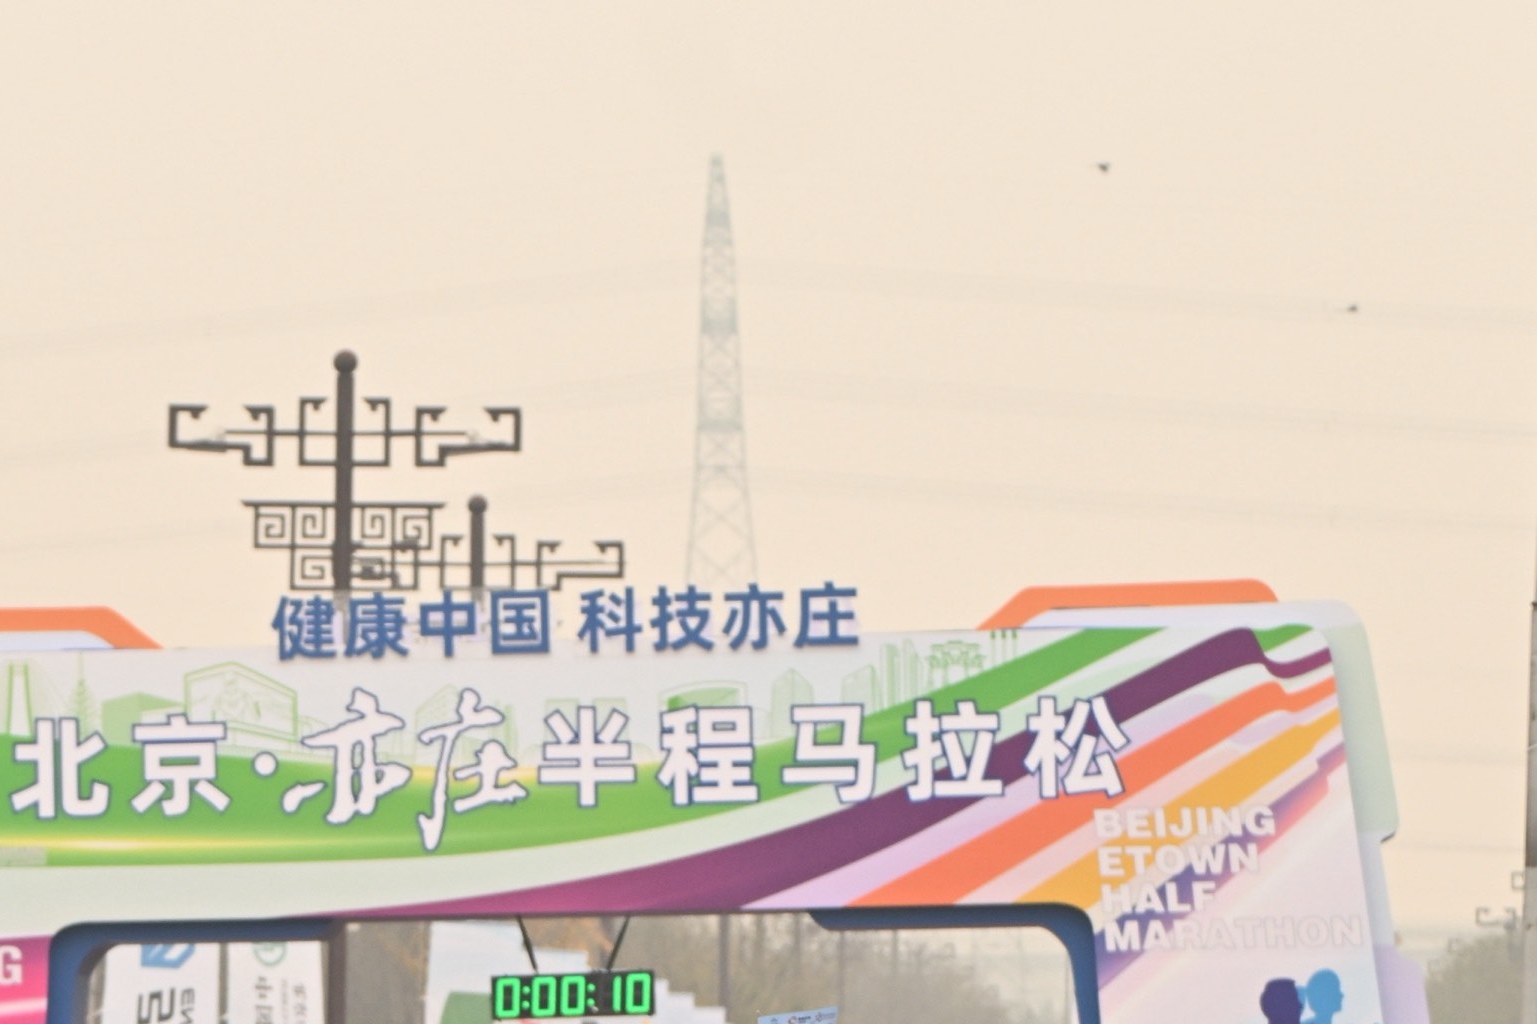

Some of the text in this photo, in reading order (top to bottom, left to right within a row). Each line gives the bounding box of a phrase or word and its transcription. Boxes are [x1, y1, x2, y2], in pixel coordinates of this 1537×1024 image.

[272, 582, 860, 660] 健康中国 科技亦庄
[1093, 804, 1276, 838] BEIJING
[1098, 842, 1259, 877] ETOWN
[1102, 881, 1216, 914] HALF
[1104, 915, 1363, 953] MARATHON
